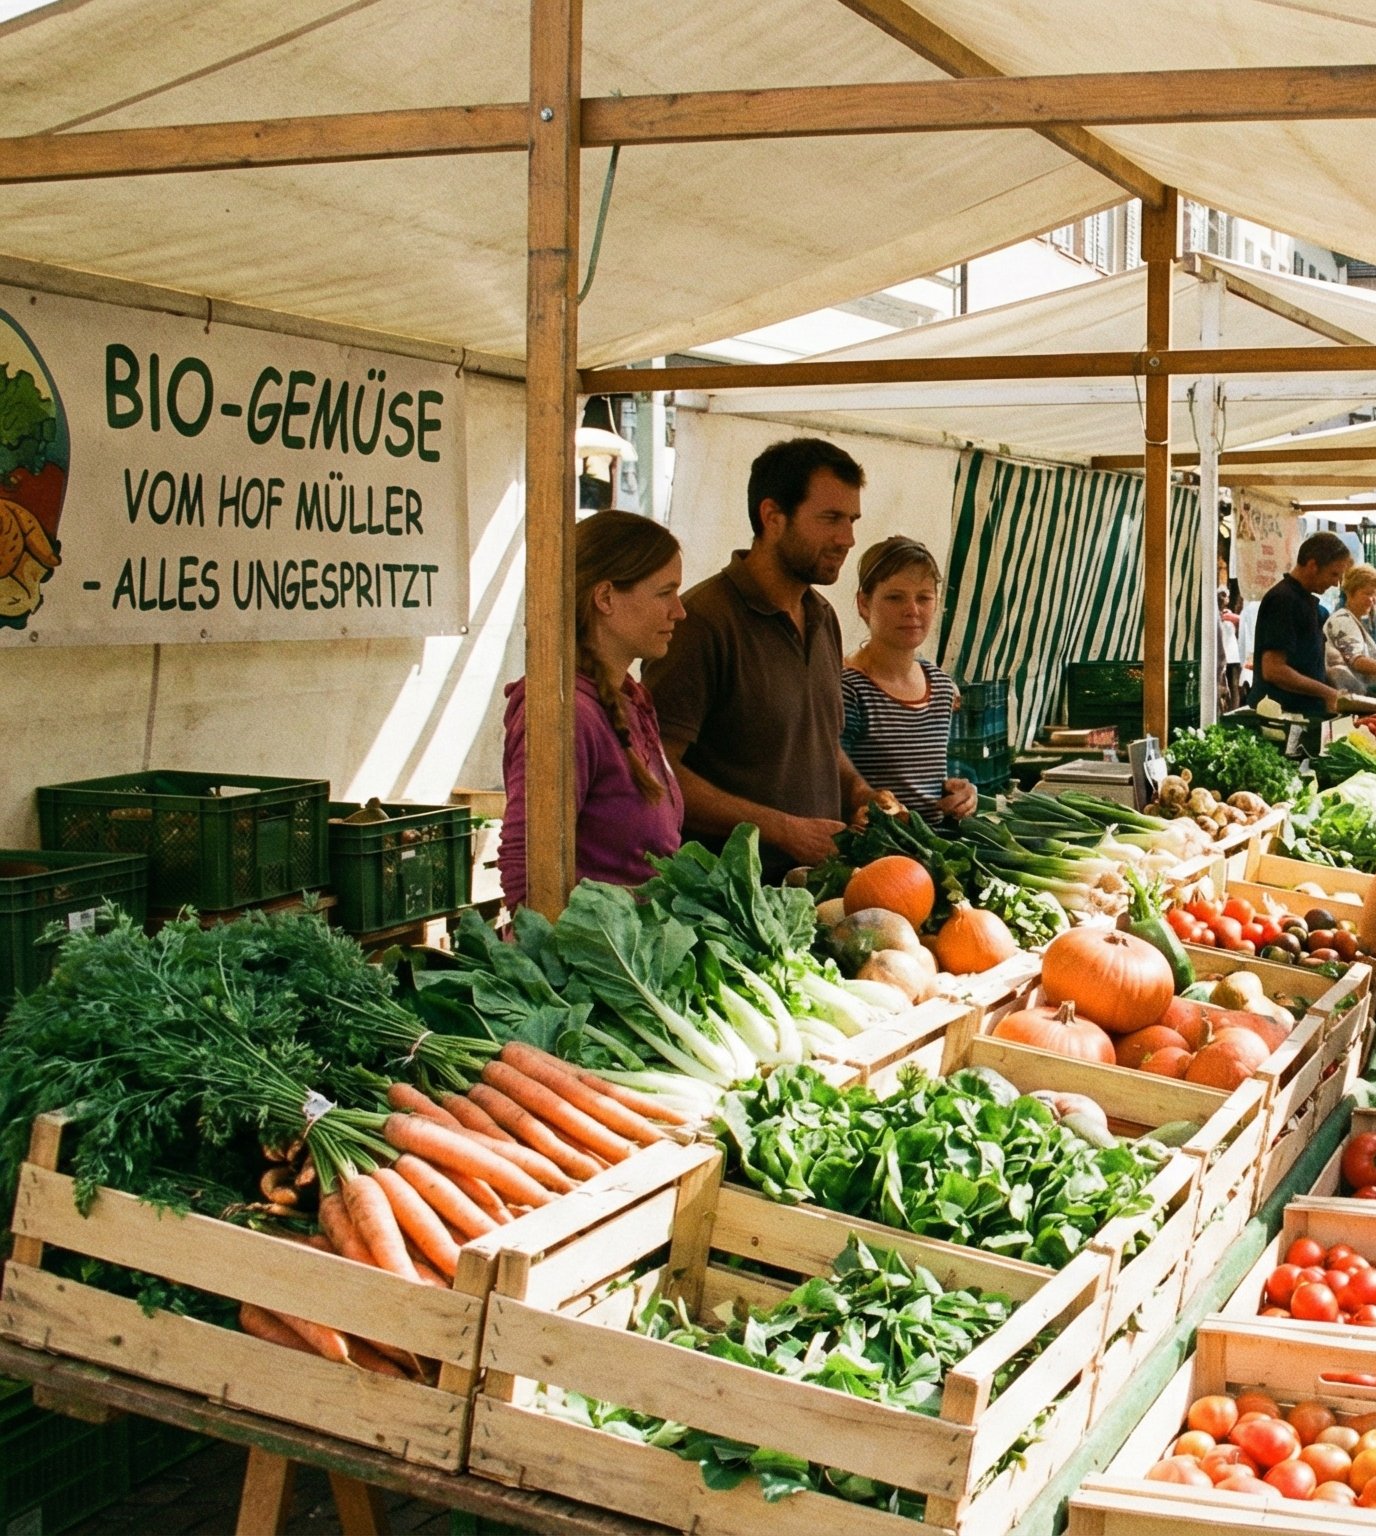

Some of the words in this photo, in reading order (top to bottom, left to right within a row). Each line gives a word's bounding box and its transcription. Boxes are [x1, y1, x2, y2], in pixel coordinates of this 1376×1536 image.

[105, 343, 444, 463] BIO-GEMÜSE
[124, 468, 205, 528] VOM
[217, 474, 285, 530] HOF
[295, 470, 424, 536] MÜLLER
[111, 556, 220, 612] ALLES
[232, 558, 439, 611] UNGESPRITZT
